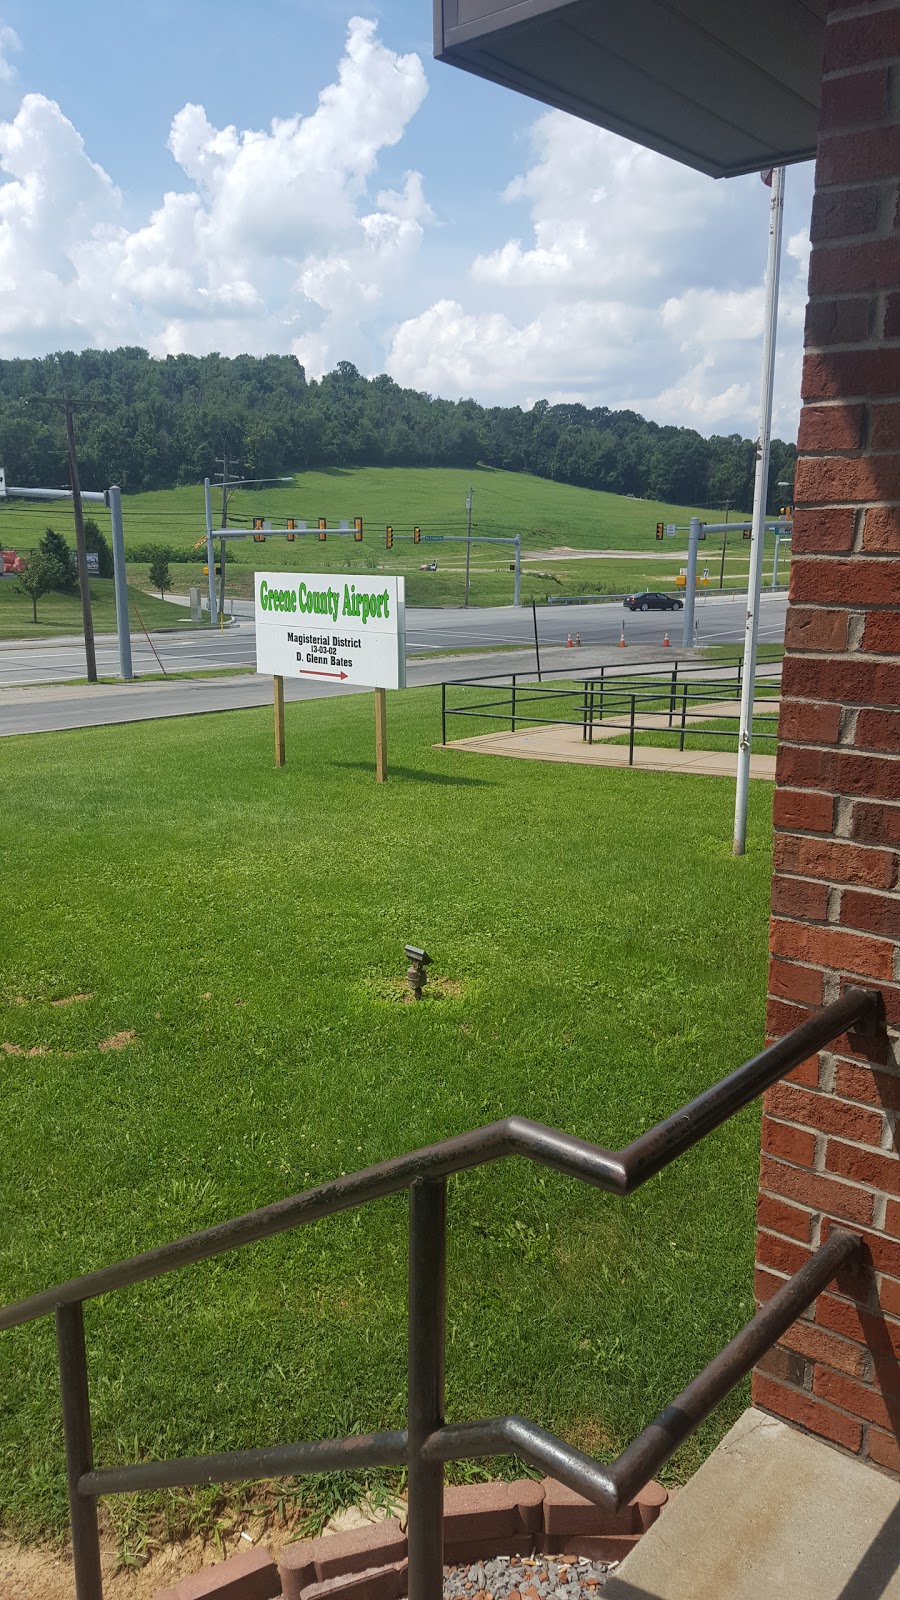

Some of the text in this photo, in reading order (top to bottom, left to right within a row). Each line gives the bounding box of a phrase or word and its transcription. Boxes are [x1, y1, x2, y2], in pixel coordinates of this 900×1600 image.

[260, 580, 390, 625] Greene County Airport
[287, 632, 362, 648] Magisterial District
[296, 652, 353, 667] D. Glenn Bates
